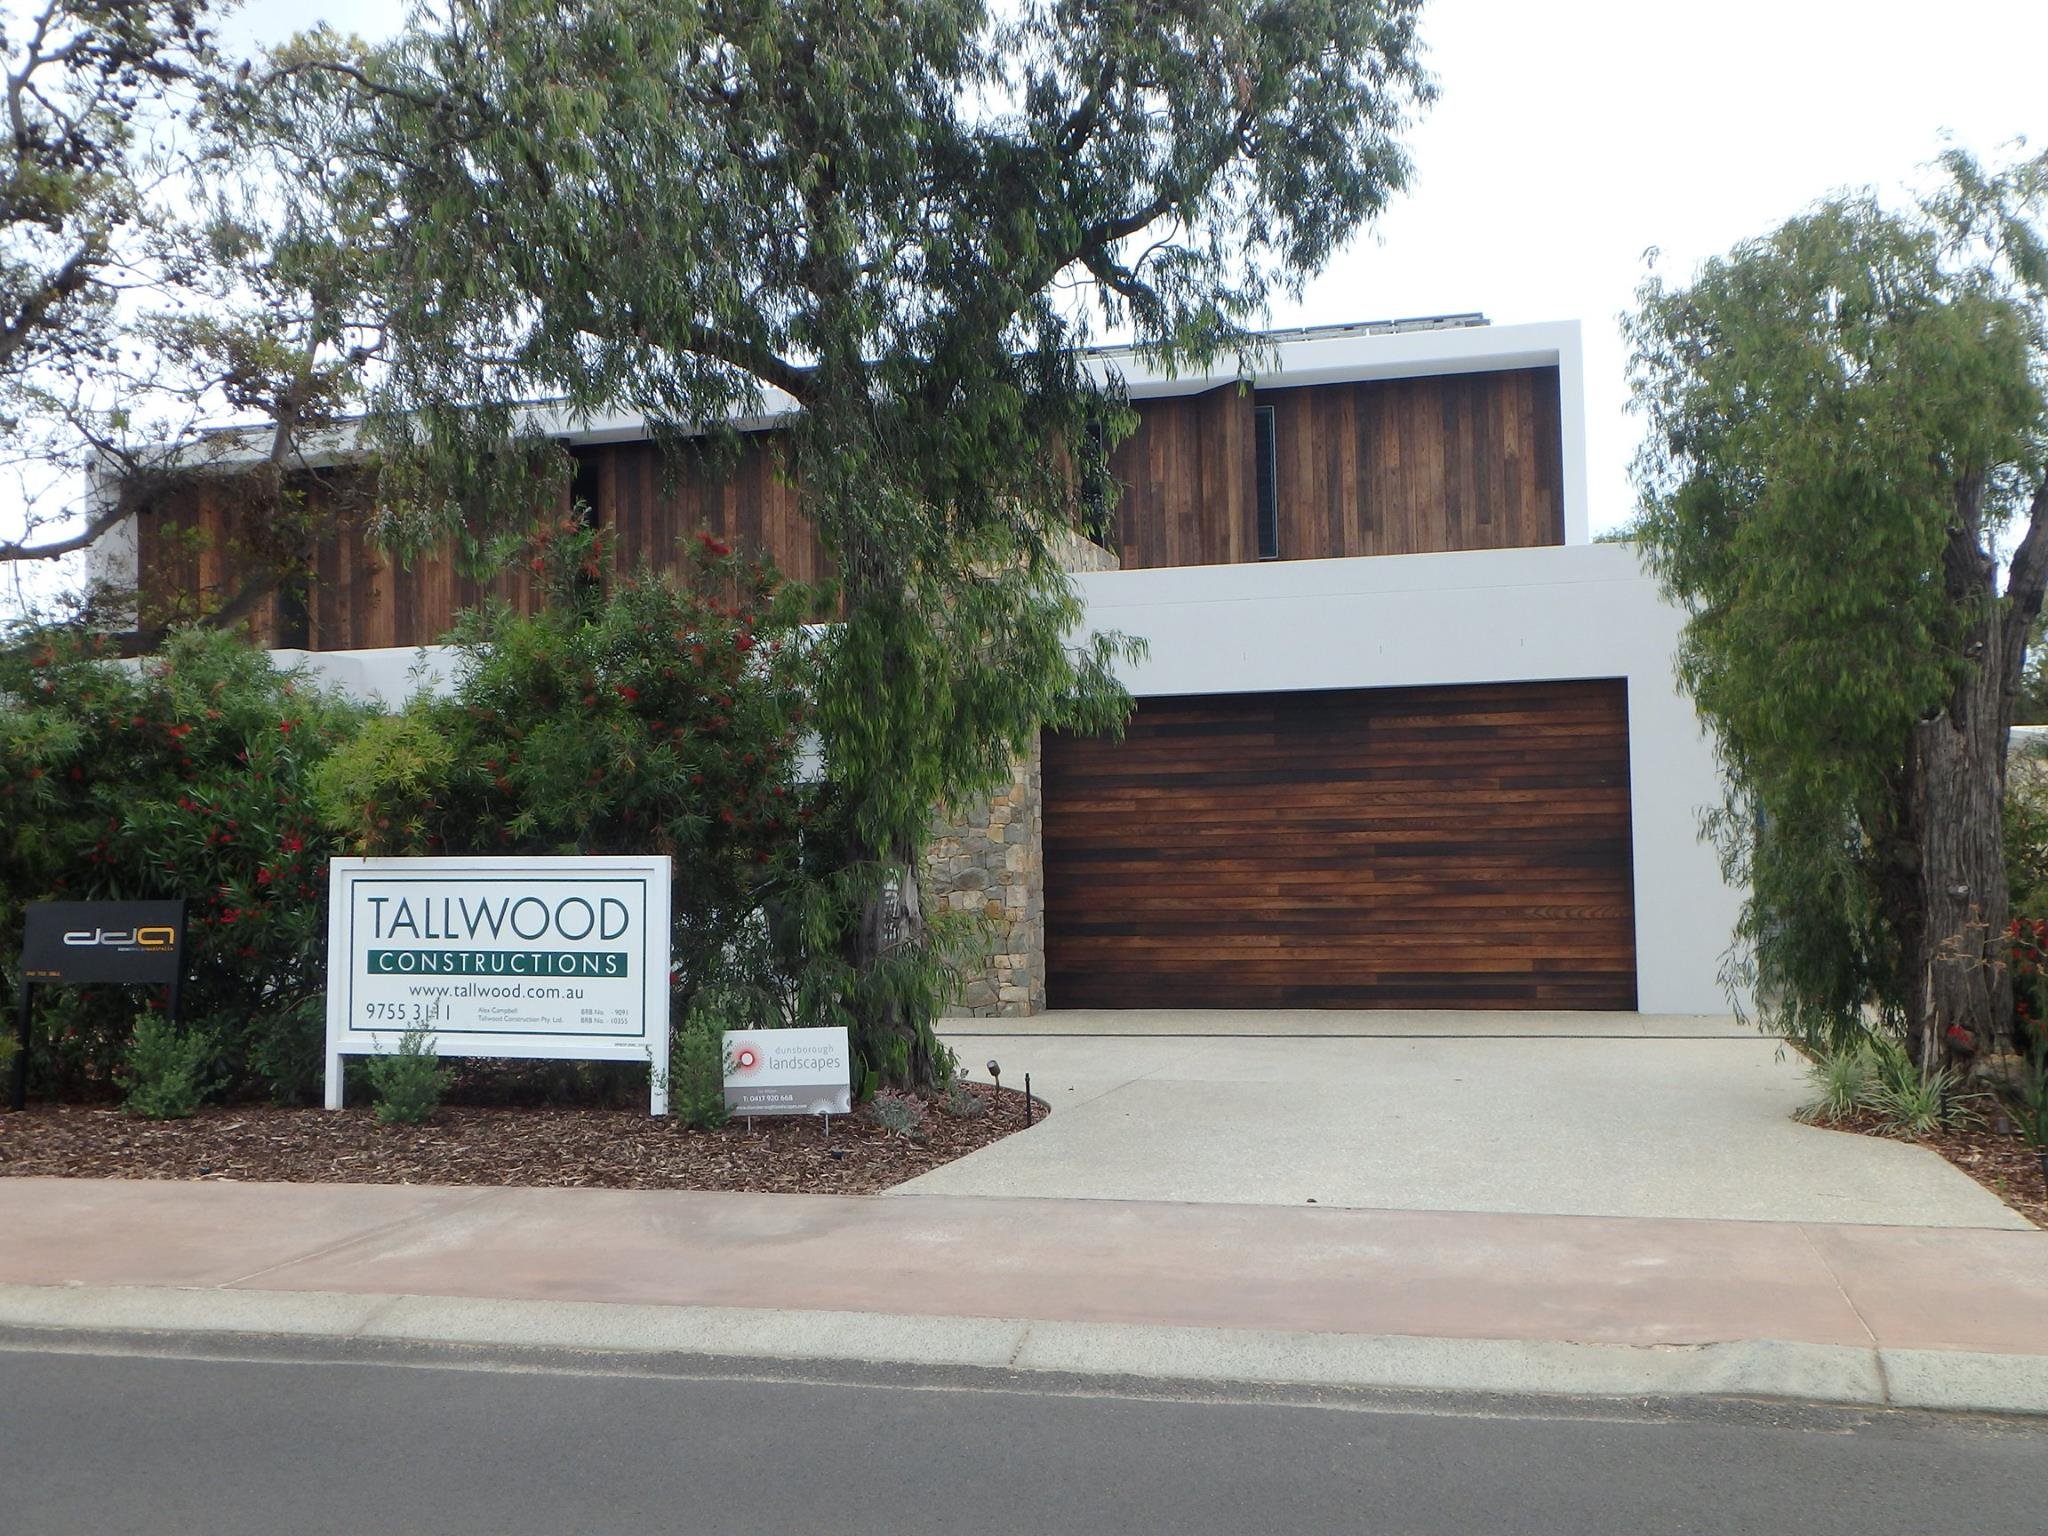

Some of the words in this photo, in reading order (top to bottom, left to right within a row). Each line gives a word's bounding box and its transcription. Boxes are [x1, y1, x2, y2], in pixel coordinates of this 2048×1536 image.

[367, 897, 629, 940] TALLWOOD
[379, 951, 618, 974] CONSTRUCTIONS
[409, 983, 584, 1000] www.tallwood.com.au
[366, 1003, 406, 1020] 9755
[769, 1056, 841, 1071] landscapes
